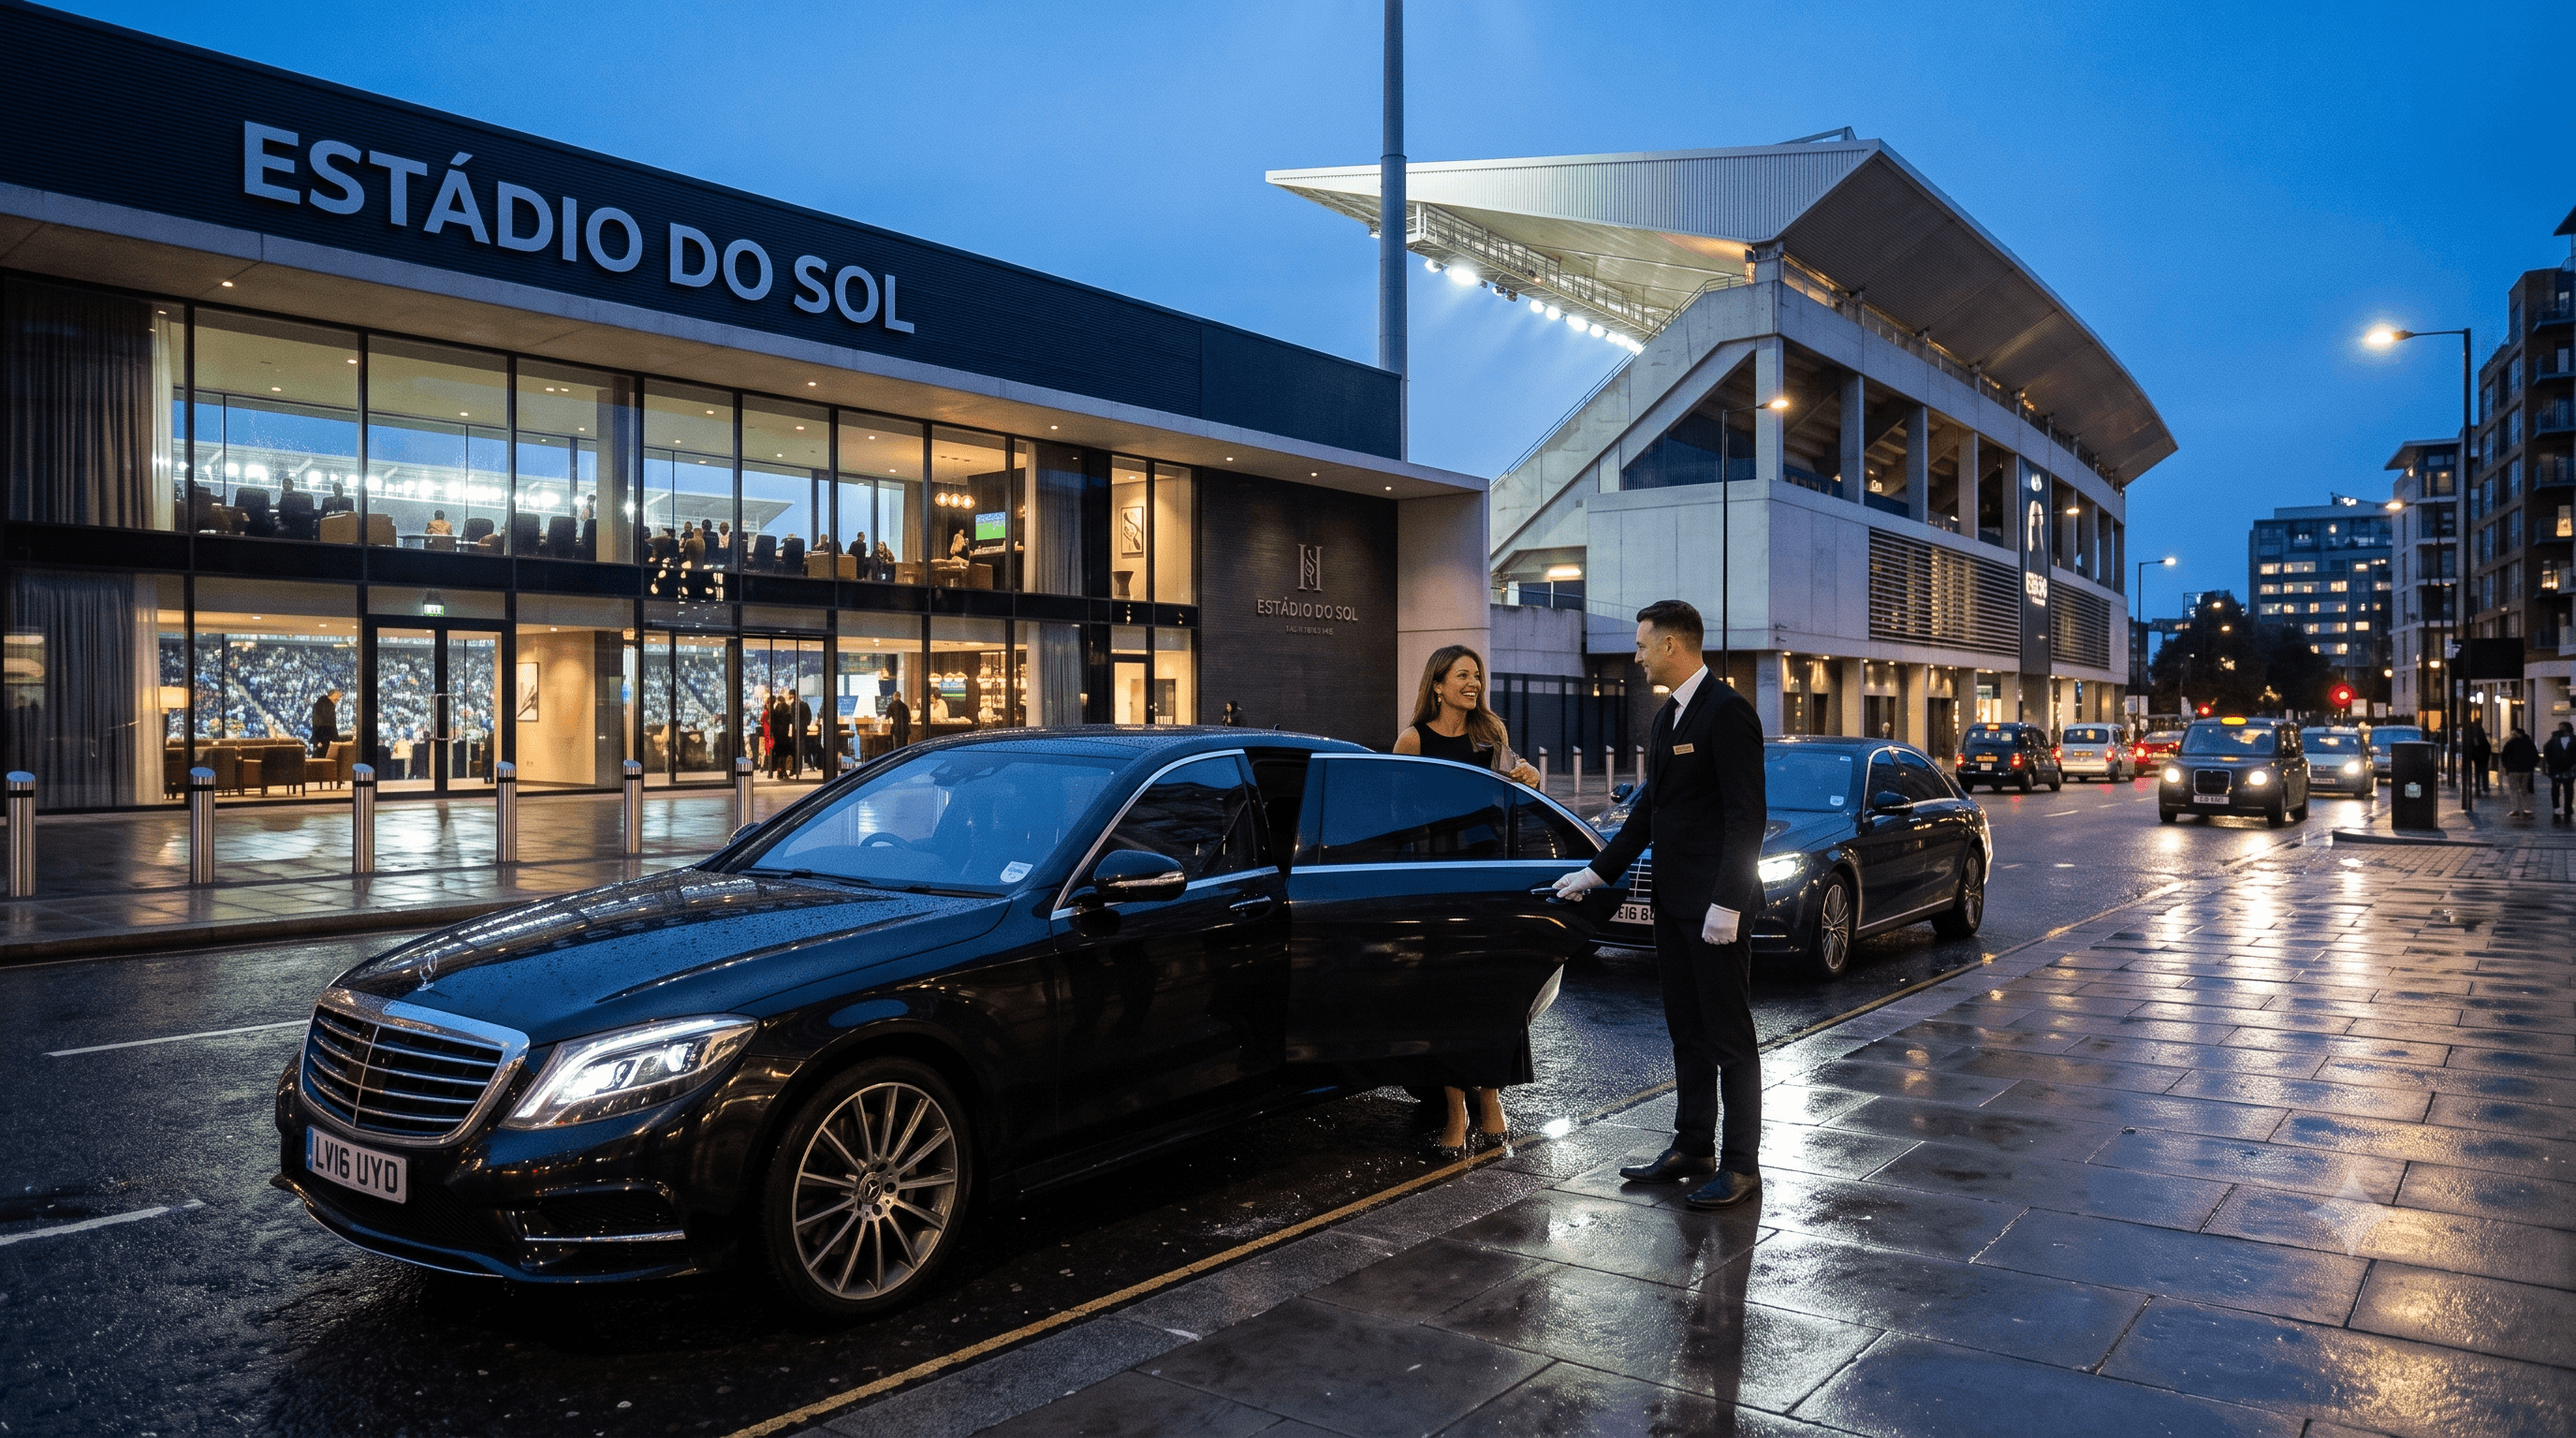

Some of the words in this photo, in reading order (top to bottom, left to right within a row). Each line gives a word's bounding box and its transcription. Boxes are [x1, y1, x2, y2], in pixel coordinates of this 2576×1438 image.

[243, 120, 643, 273] ESTÁDIO
[668, 222, 773, 301] DO
[793, 255, 915, 334] SOL
[1315, 604, 1333, 620] DO
[1336, 606, 1358, 622] SOL
[315, 1136, 350, 1180] LV16
[357, 1152, 398, 1195] UYD
